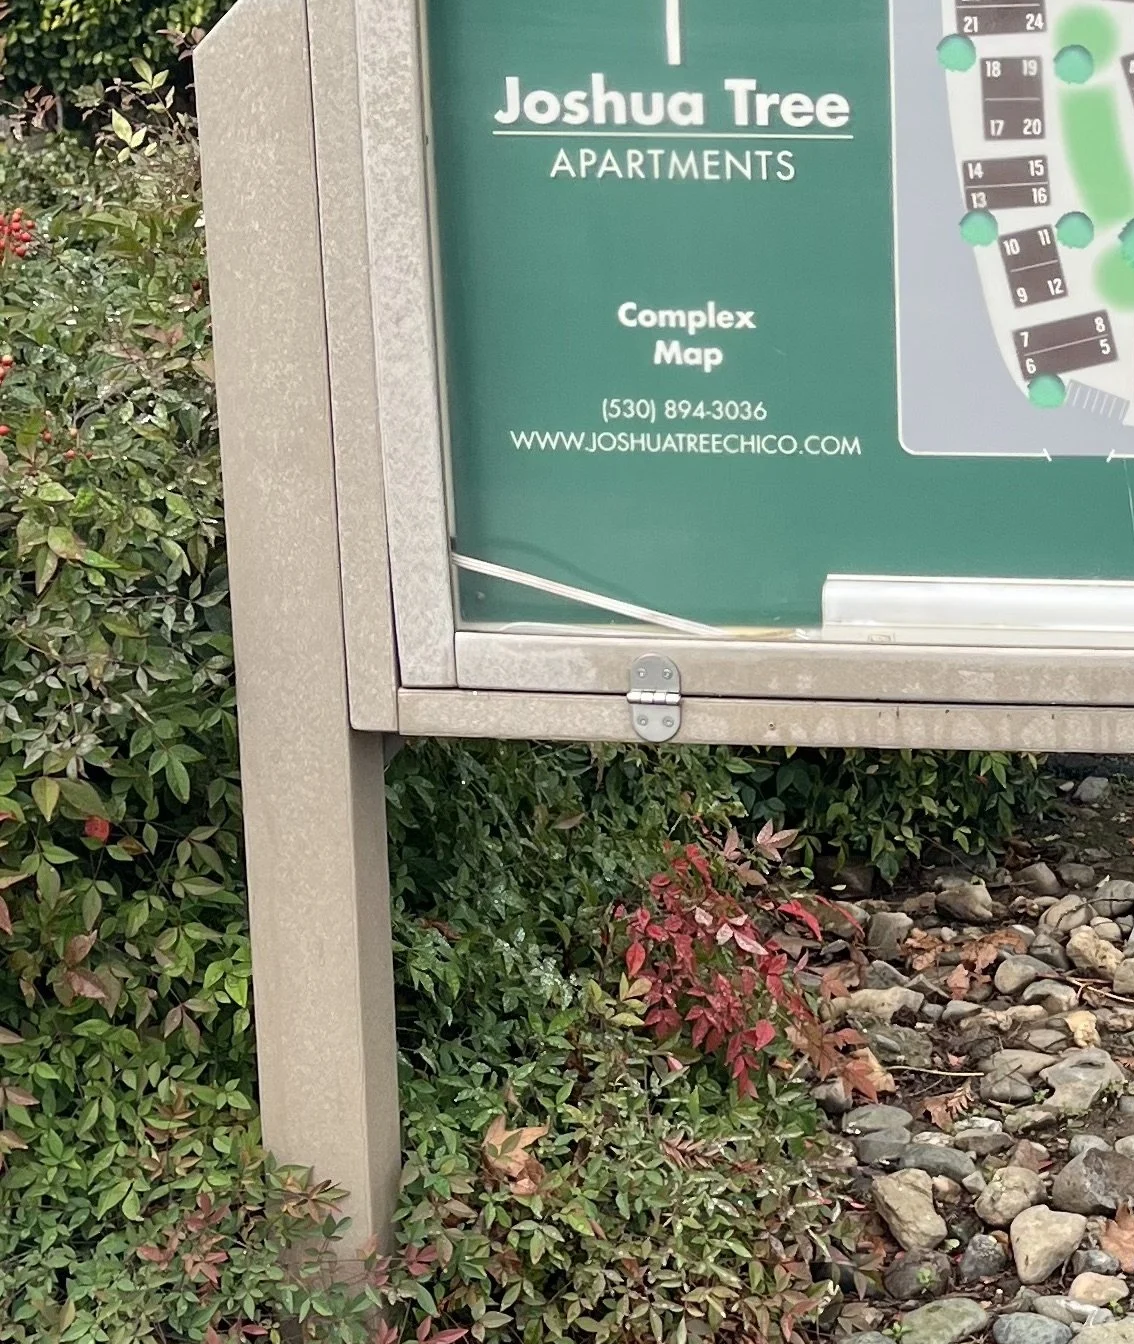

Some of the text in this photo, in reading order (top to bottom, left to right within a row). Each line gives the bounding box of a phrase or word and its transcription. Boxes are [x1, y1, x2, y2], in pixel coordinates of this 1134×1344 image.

[964, 17, 978, 32] 21
[1026, 13, 1043, 30] 24
[986, 61, 1000, 77] 18
[1023, 60, 1037, 76] 19
[494, 73, 850, 127] Joshua Tree
[990, 120, 1004, 136] 17
[1023, 118, 1041, 134] 20
[550, 148, 795, 180] APARTMENTS
[968, 163, 984, 179] 14
[1029, 160, 1044, 176] 15
[971, 192, 987, 208] 13
[1032, 187, 1047, 204] 16
[1038, 229, 1051, 246] 11
[1003, 238, 1020, 255] 10
[1047, 278, 1064, 295] 12
[1017, 287, 1027, 303] 9
[618, 301, 757, 335] Complex
[1095, 317, 1105, 332] 8
[1020, 332, 1029, 347] 7
[1100, 339, 1110, 354] 5
[654, 340, 723, 373] Map
[1026, 358, 1036, 373] 6
[602, 399, 767, 424] (530) 894-3036
[510, 430, 862, 456] WWW.JOSHUATREECHICO.COM
